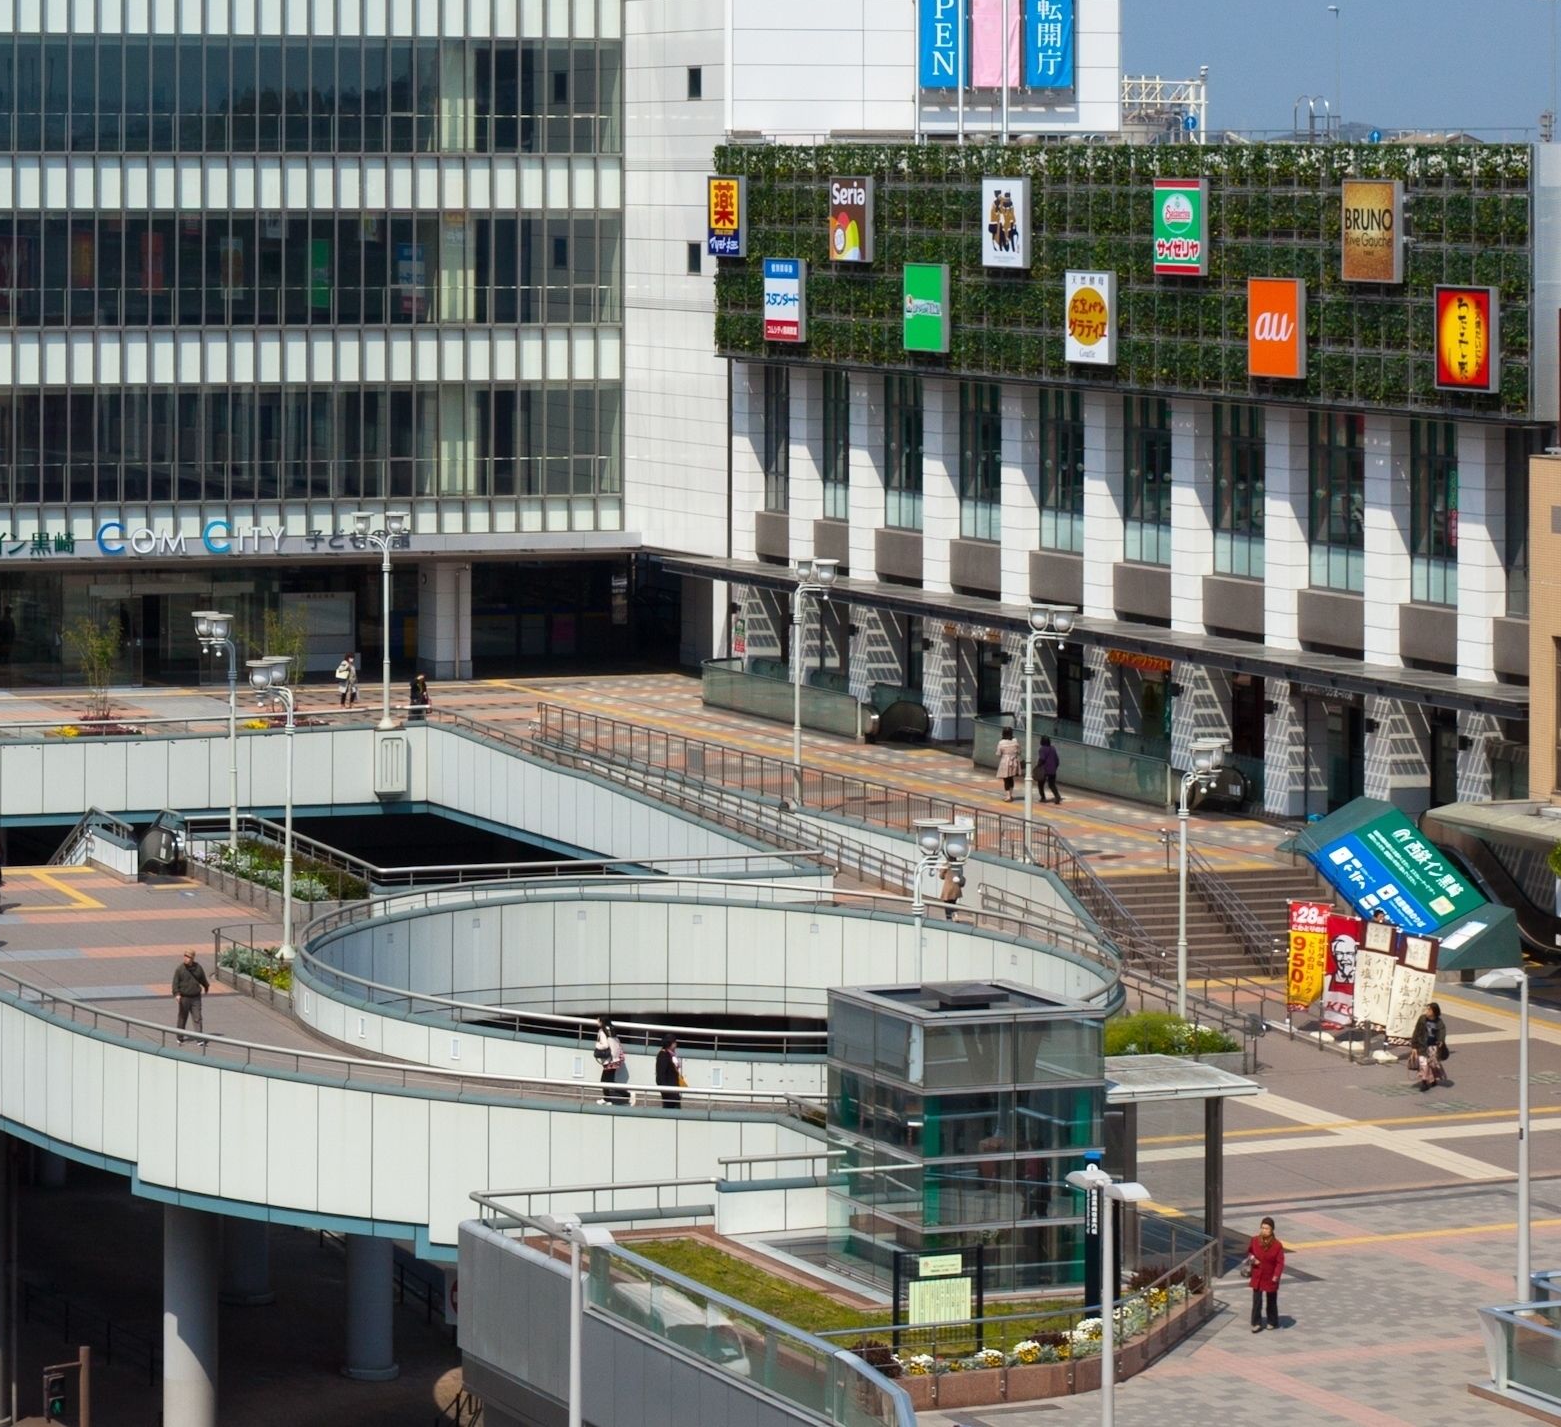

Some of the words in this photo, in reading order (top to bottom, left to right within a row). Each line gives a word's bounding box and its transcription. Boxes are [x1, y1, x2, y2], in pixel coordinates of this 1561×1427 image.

[714, 182, 734, 226] 薬
[832, 181, 865, 205] Seria
[1345, 208, 1393, 231] BRUNO
[1157, 240, 1199, 259] サイゼリヤ
[766, 292, 799, 307] スタンダード
[1255, 312, 1295, 342] au
[97, 522, 186, 555] COM
[203, 520, 284, 554] CITY
[1404, 840, 1464, 898] 西鉄イン黒崎
